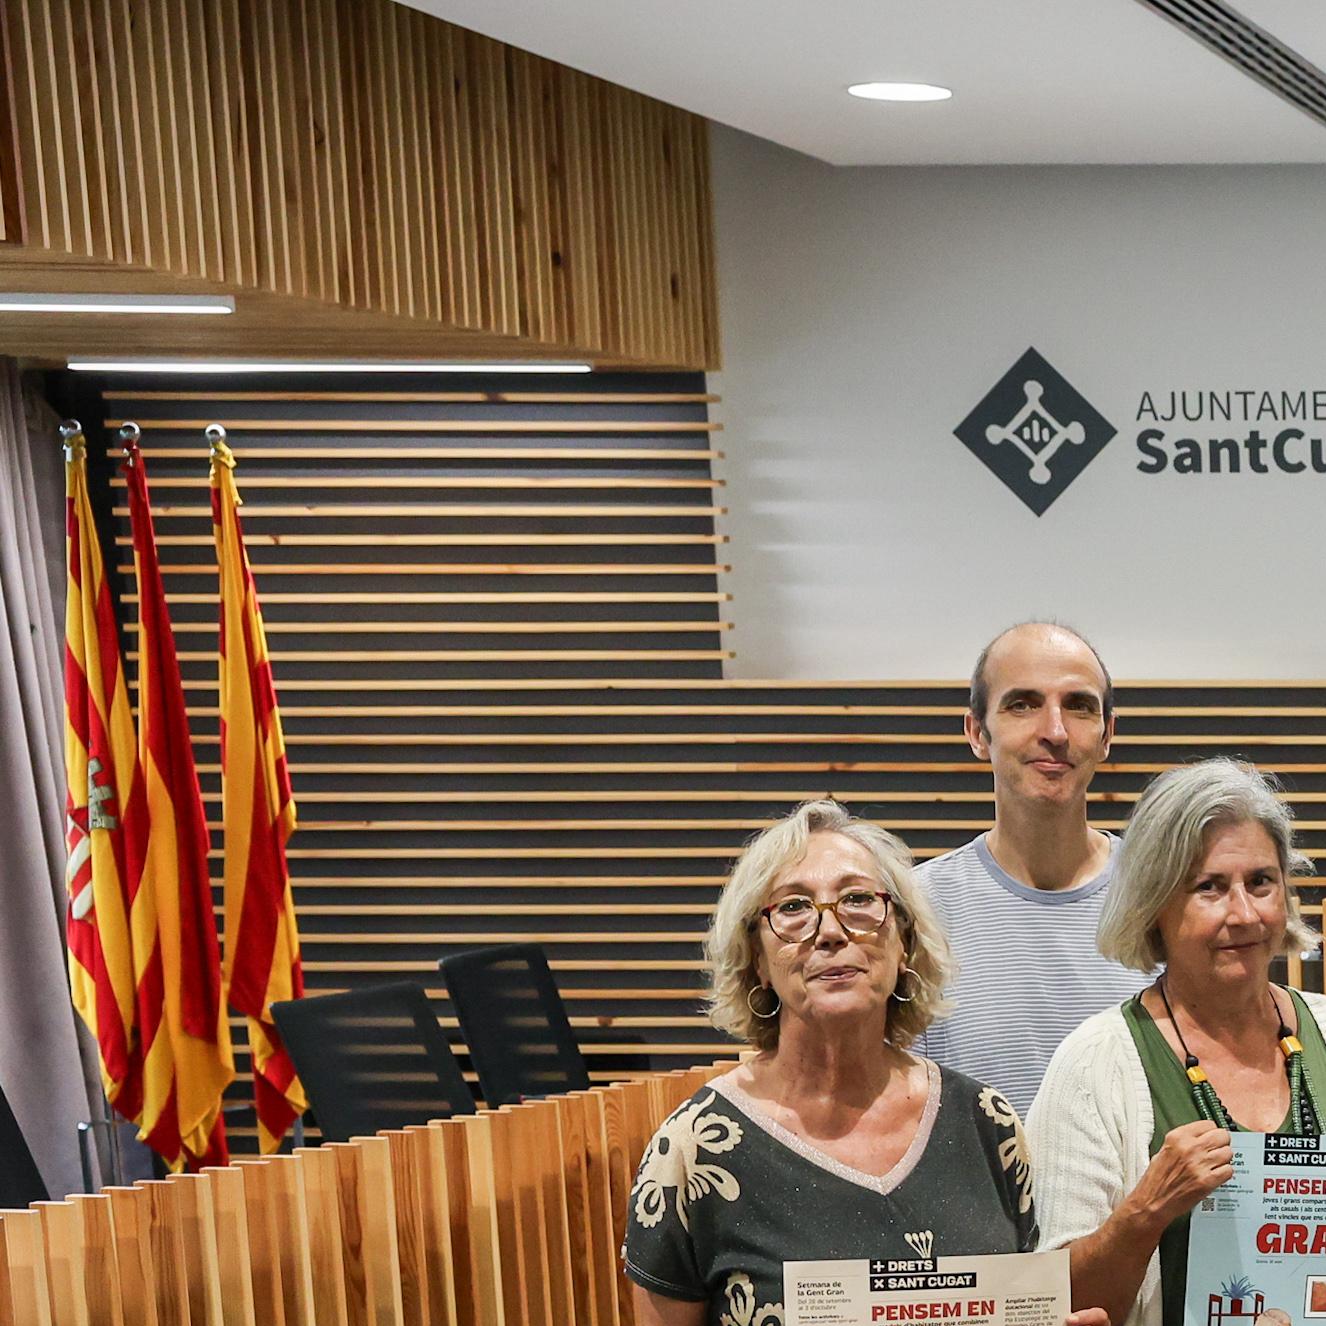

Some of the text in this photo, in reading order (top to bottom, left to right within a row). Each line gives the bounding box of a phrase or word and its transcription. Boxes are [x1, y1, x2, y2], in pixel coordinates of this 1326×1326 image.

[1280, 1137, 1317, 1148] DRETS
[1279, 1154, 1309, 1164] SANT
[888, 1260, 934, 1272] DRETS
[888, 1277, 925, 1289] SANT
[928, 1275, 973, 1287] CUGAT
[872, 1302, 961, 1321] PENSEM
[968, 1300, 995, 1316] EN
